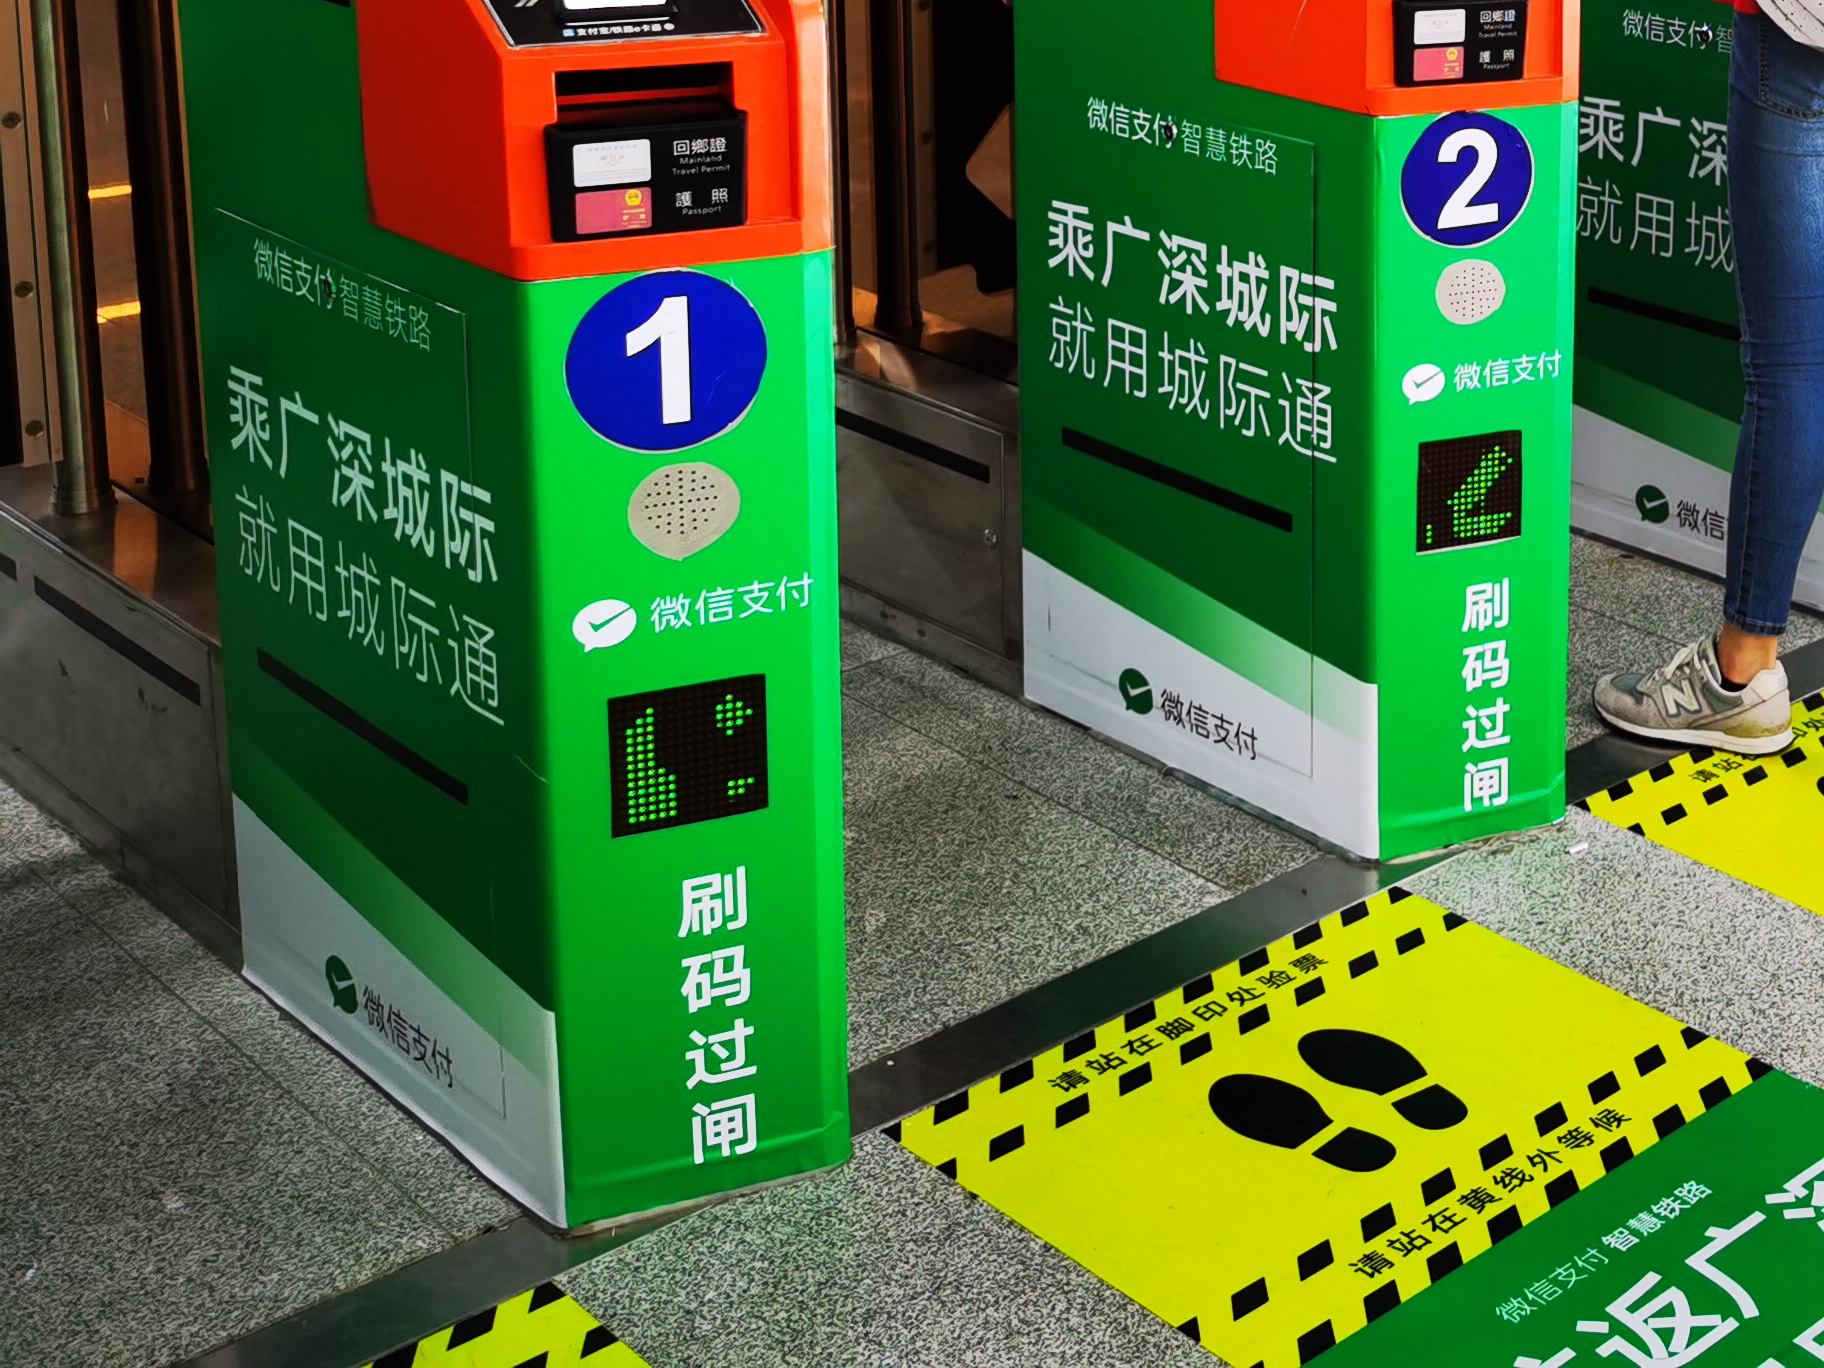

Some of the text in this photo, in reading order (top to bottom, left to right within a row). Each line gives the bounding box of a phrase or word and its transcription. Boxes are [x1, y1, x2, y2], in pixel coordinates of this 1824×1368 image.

[671, 164, 731, 176] Travel Permit
[673, 137, 727, 156] 回鄉證
[679, 154, 722, 165] Mainland
[1437, 127, 1499, 230] 2
[1578, 95, 1730, 186] 乘广深
[682, 206, 722, 216] Passport
[1575, 176, 1734, 273] 就用城
[1047, 199, 1338, 354] 乘广深城际
[625, 295, 691, 425] 1
[1048, 296, 1337, 464] 就用城际通
[1453, 349, 1562, 393] 微信支付
[227, 366, 498, 583] 乘广深城际
[235, 486, 504, 727] 就用城际通
[649, 571, 814, 634] 微信支付
[1160, 688, 1258, 761] 微信支付
[1461, 577, 1511, 813] 刷码过闸
[1662, 678, 1702, 718] N
[363, 985, 453, 1089] 微信支付
[677, 866, 757, 1164] 刷码过闸
[1047, 949, 1330, 1096] 请站在脚印处验票
[1346, 1106, 1635, 1281] 请站在黄线外等候
[1495, 1180, 1713, 1324] 微信支付智慧铁路
